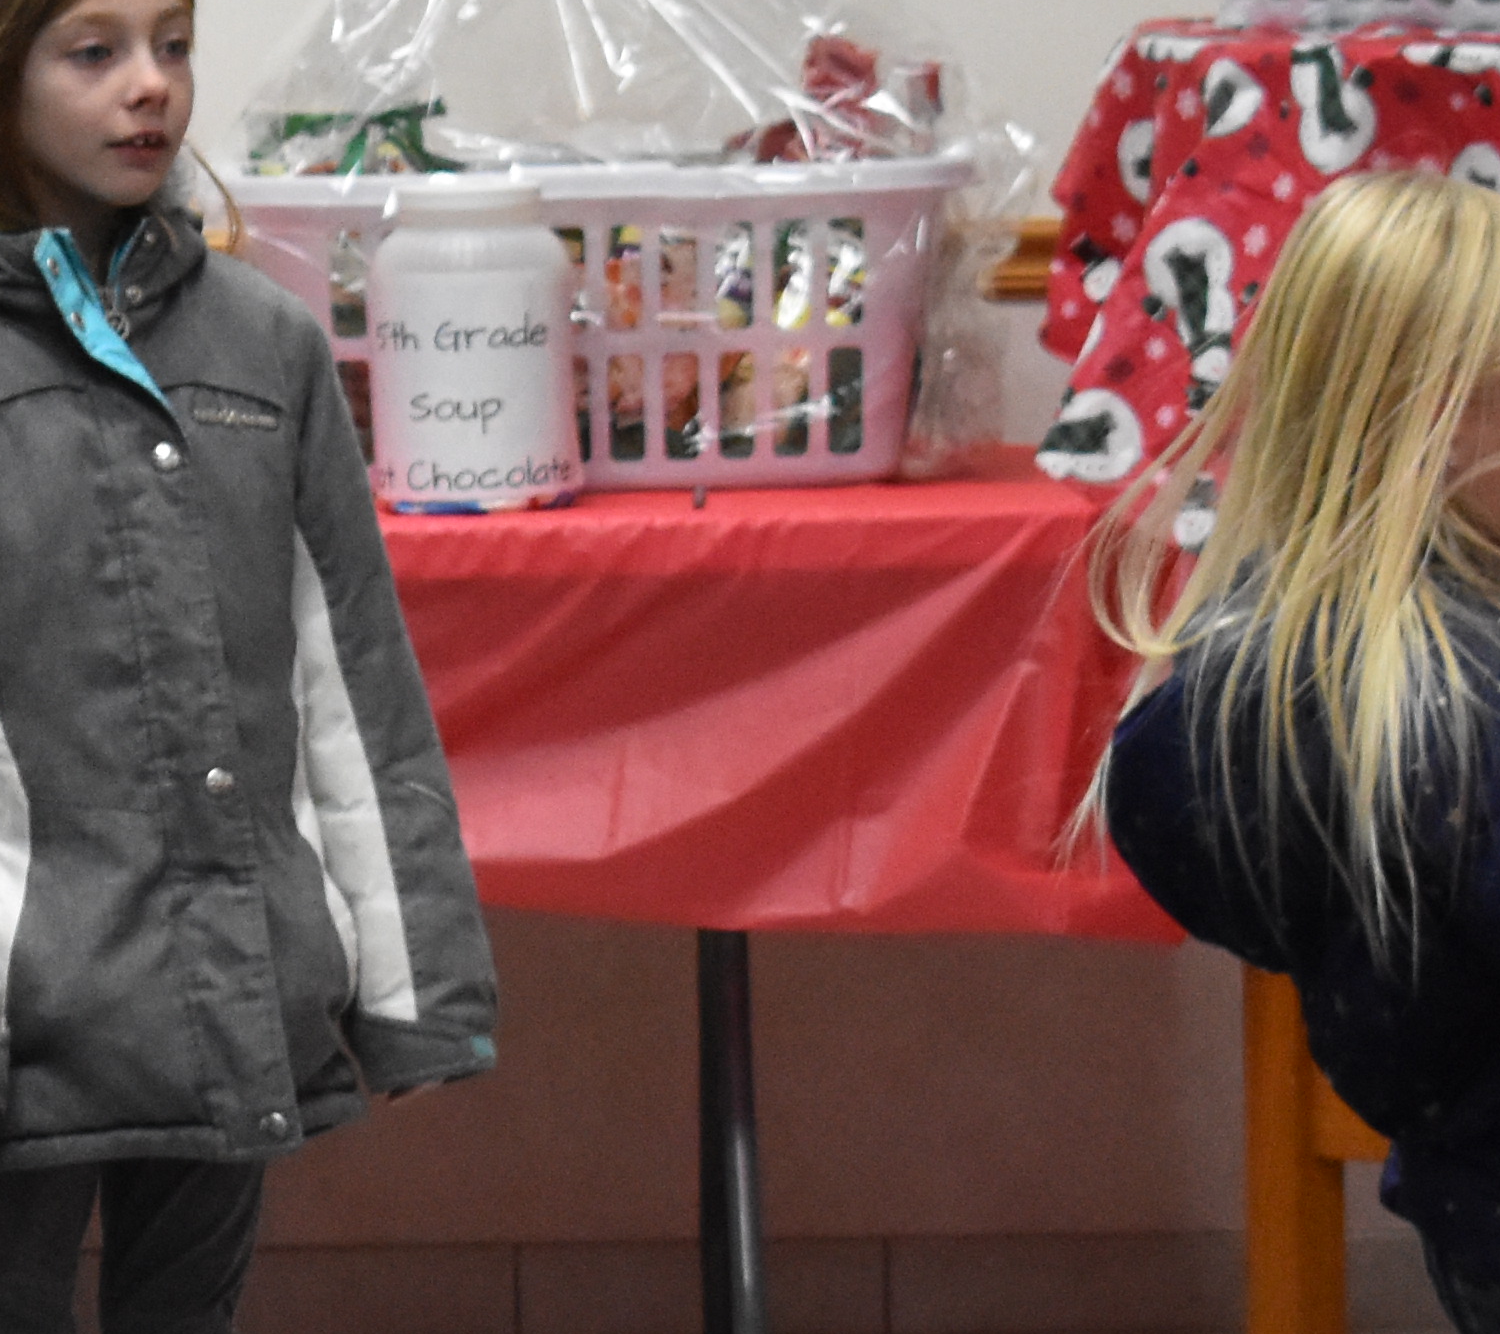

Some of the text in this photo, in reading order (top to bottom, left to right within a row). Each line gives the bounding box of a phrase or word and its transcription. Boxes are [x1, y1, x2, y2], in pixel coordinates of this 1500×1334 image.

[433, 311, 549, 352] Grade
[408, 391, 505, 436] Soup
[406, 454, 571, 492] Chocolate
